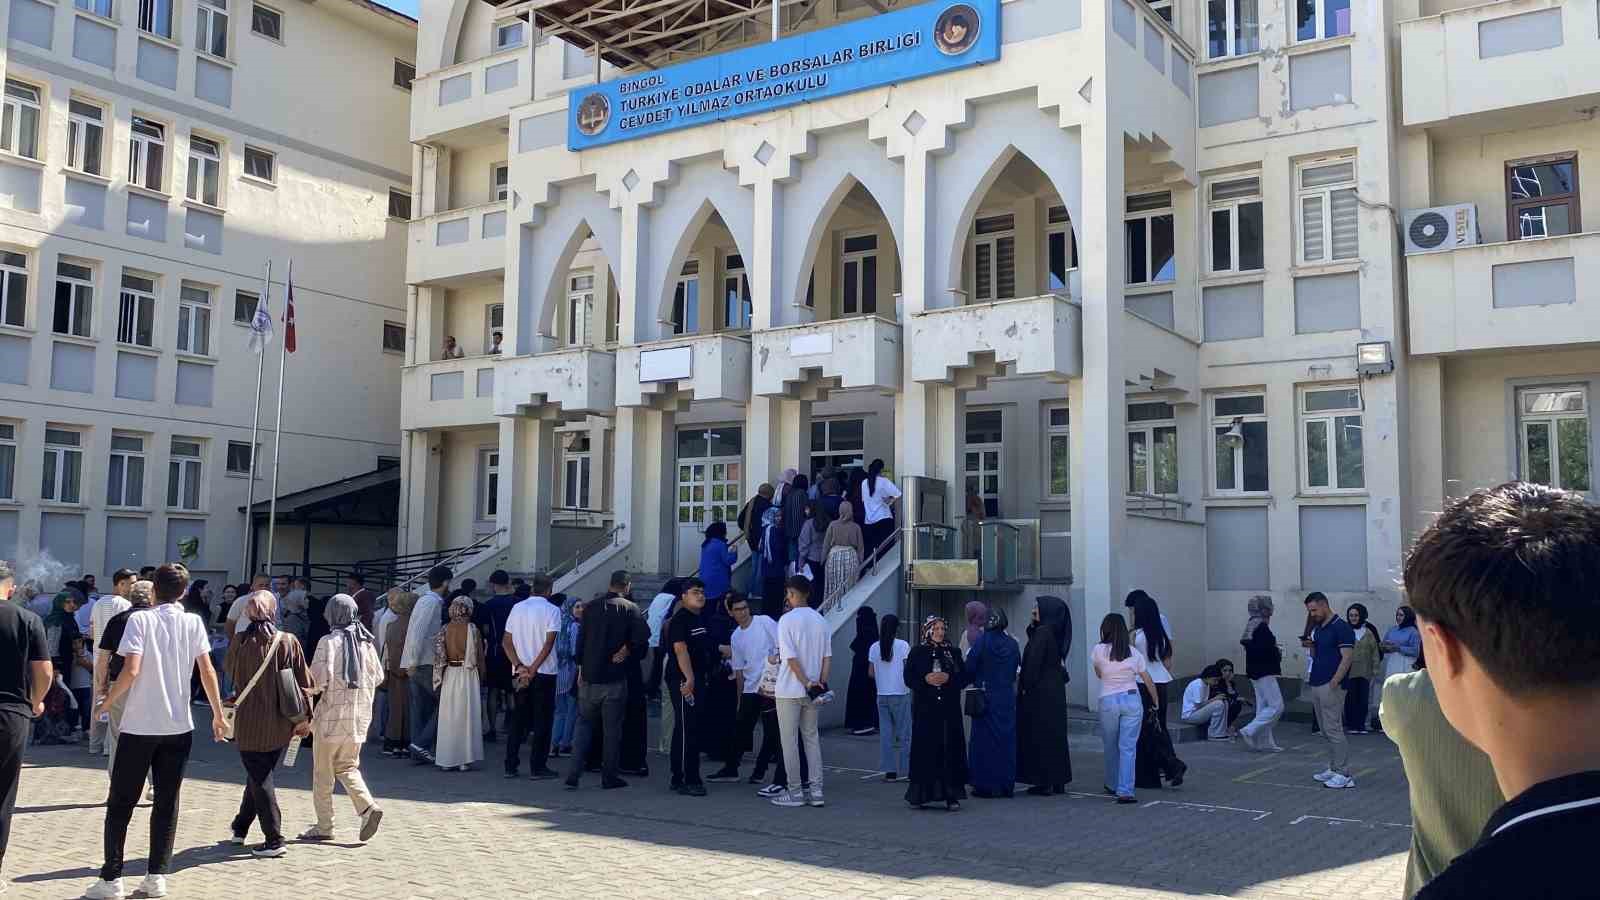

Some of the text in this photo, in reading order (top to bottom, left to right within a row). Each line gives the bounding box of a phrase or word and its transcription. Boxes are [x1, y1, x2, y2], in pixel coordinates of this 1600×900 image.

[684, 74, 741, 97] ODALAR
[746, 69, 764, 82] VE
[770, 48, 852, 77] BORSALAR
[620, 73, 827, 129] CEVDET YILMAZ ORTAOKULU
